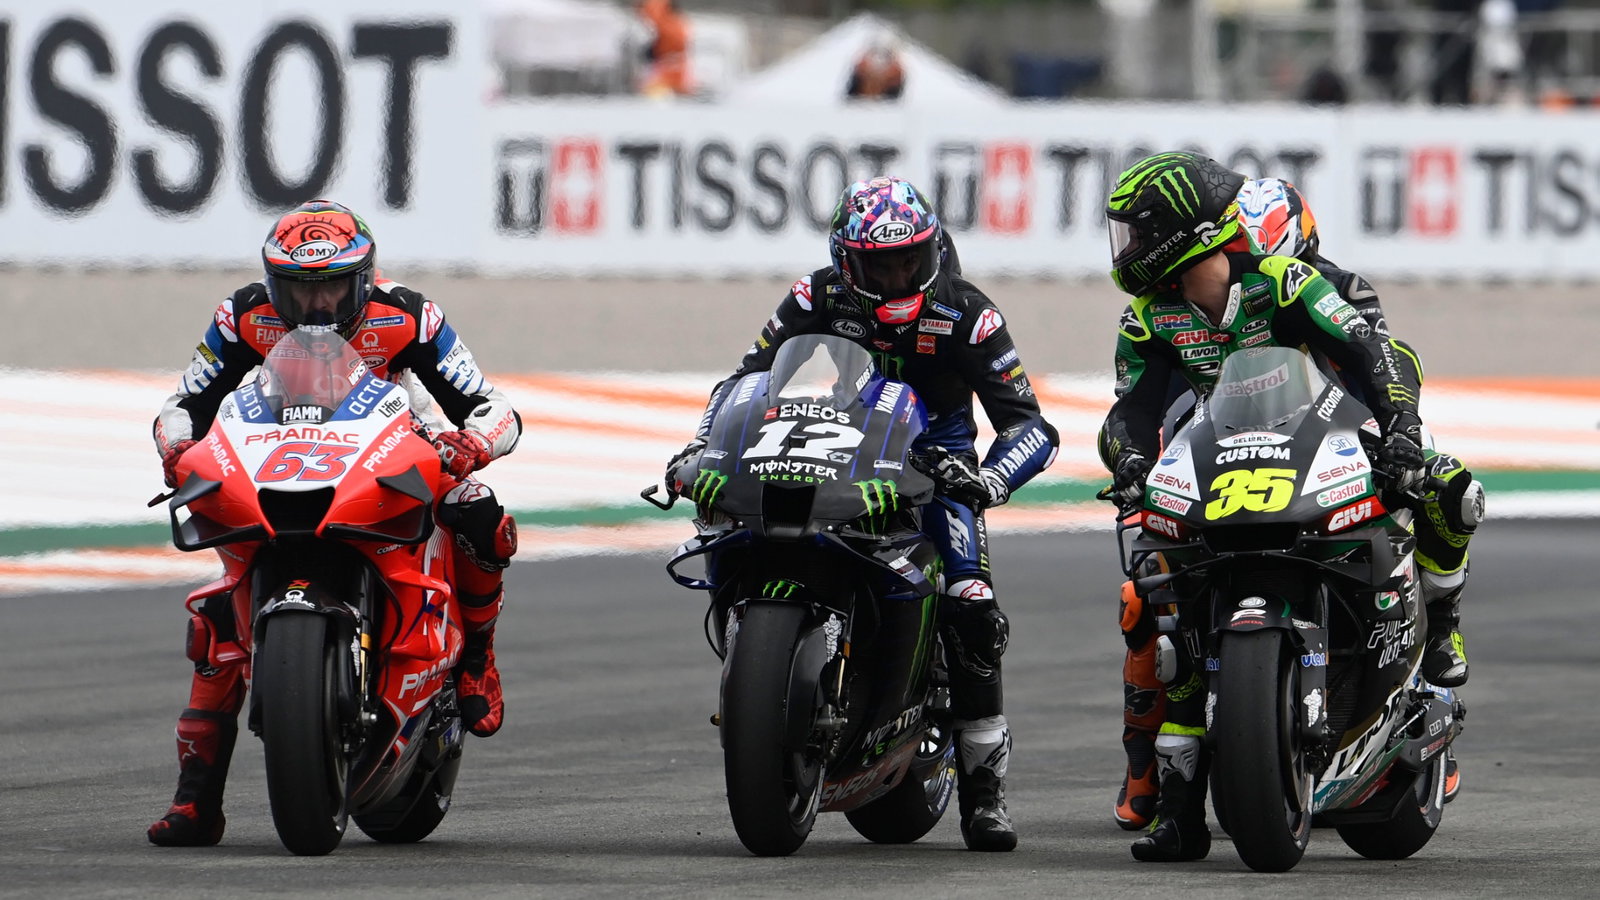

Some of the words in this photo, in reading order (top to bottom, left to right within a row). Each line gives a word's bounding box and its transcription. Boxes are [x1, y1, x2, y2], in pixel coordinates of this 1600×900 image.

[879, 223, 908, 238] Arai
[293, 247, 335, 258] SUOMY
[1141, 230, 1188, 266] MONSTER
[838, 320, 862, 334] Arai
[926, 321, 952, 329] YAMAHA
[1153, 314, 1192, 332] HRC
[1241, 319, 1267, 333] HJC
[1172, 330, 1210, 346] GIVI
[1245, 332, 1271, 348] Castrol
[1183, 346, 1219, 359] LAVOR
[348, 377, 388, 415] OCTO
[378, 396, 406, 418] Lifter
[874, 382, 905, 414] YAMAHA
[1315, 383, 1345, 422] rizoma
[283, 406, 322, 421] FIAMM
[779, 402, 851, 425] ENEOS
[245, 427, 360, 446] PRAMAC
[741, 420, 866, 462] 12
[206, 431, 237, 478] PRAMAC
[362, 424, 411, 473] PRAMAC
[993, 426, 1049, 479] YAMAHA
[1215, 446, 1291, 465] CUSTOM
[253, 441, 360, 483] 63
[749, 459, 839, 481] MONSTER
[1317, 461, 1367, 483] SENA
[759, 474, 826, 485] ENERGY
[1154, 472, 1192, 492] SENA
[1204, 467, 1298, 521] 35
[1328, 481, 1365, 503] Castrol
[1158, 493, 1190, 514] Castrol
[1146, 514, 1180, 539] GIVI
[1327, 501, 1372, 532] GIVI
